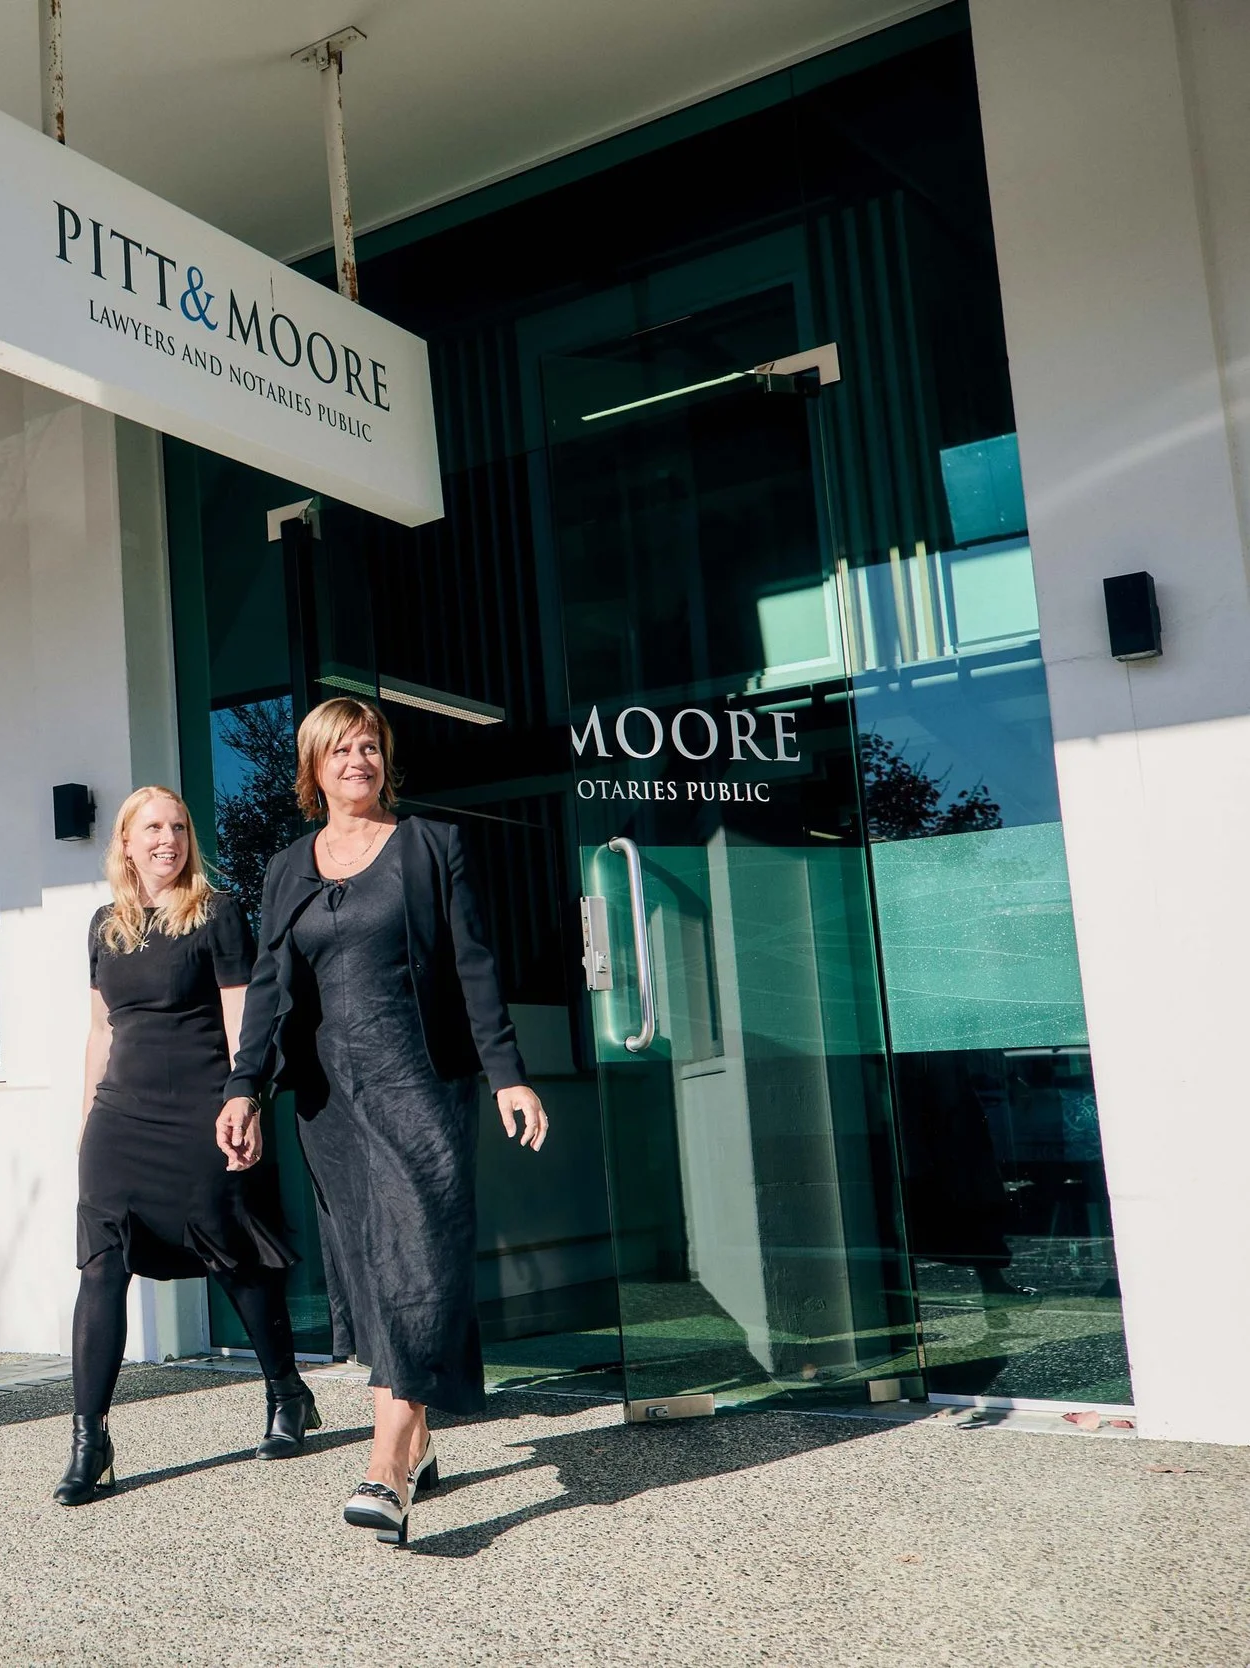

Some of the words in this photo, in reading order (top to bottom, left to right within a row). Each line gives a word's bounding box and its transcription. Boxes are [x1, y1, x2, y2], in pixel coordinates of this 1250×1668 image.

[89, 299, 176, 357] LAWYERS
[181, 343, 223, 377] AND
[229, 366, 312, 418] NOTARIES
[318, 403, 373, 443] PUBLIC
[571, 704, 801, 762] MOORE
[577, 779, 678, 801] OTARIES
[686, 781, 771, 802] PUBLIC
